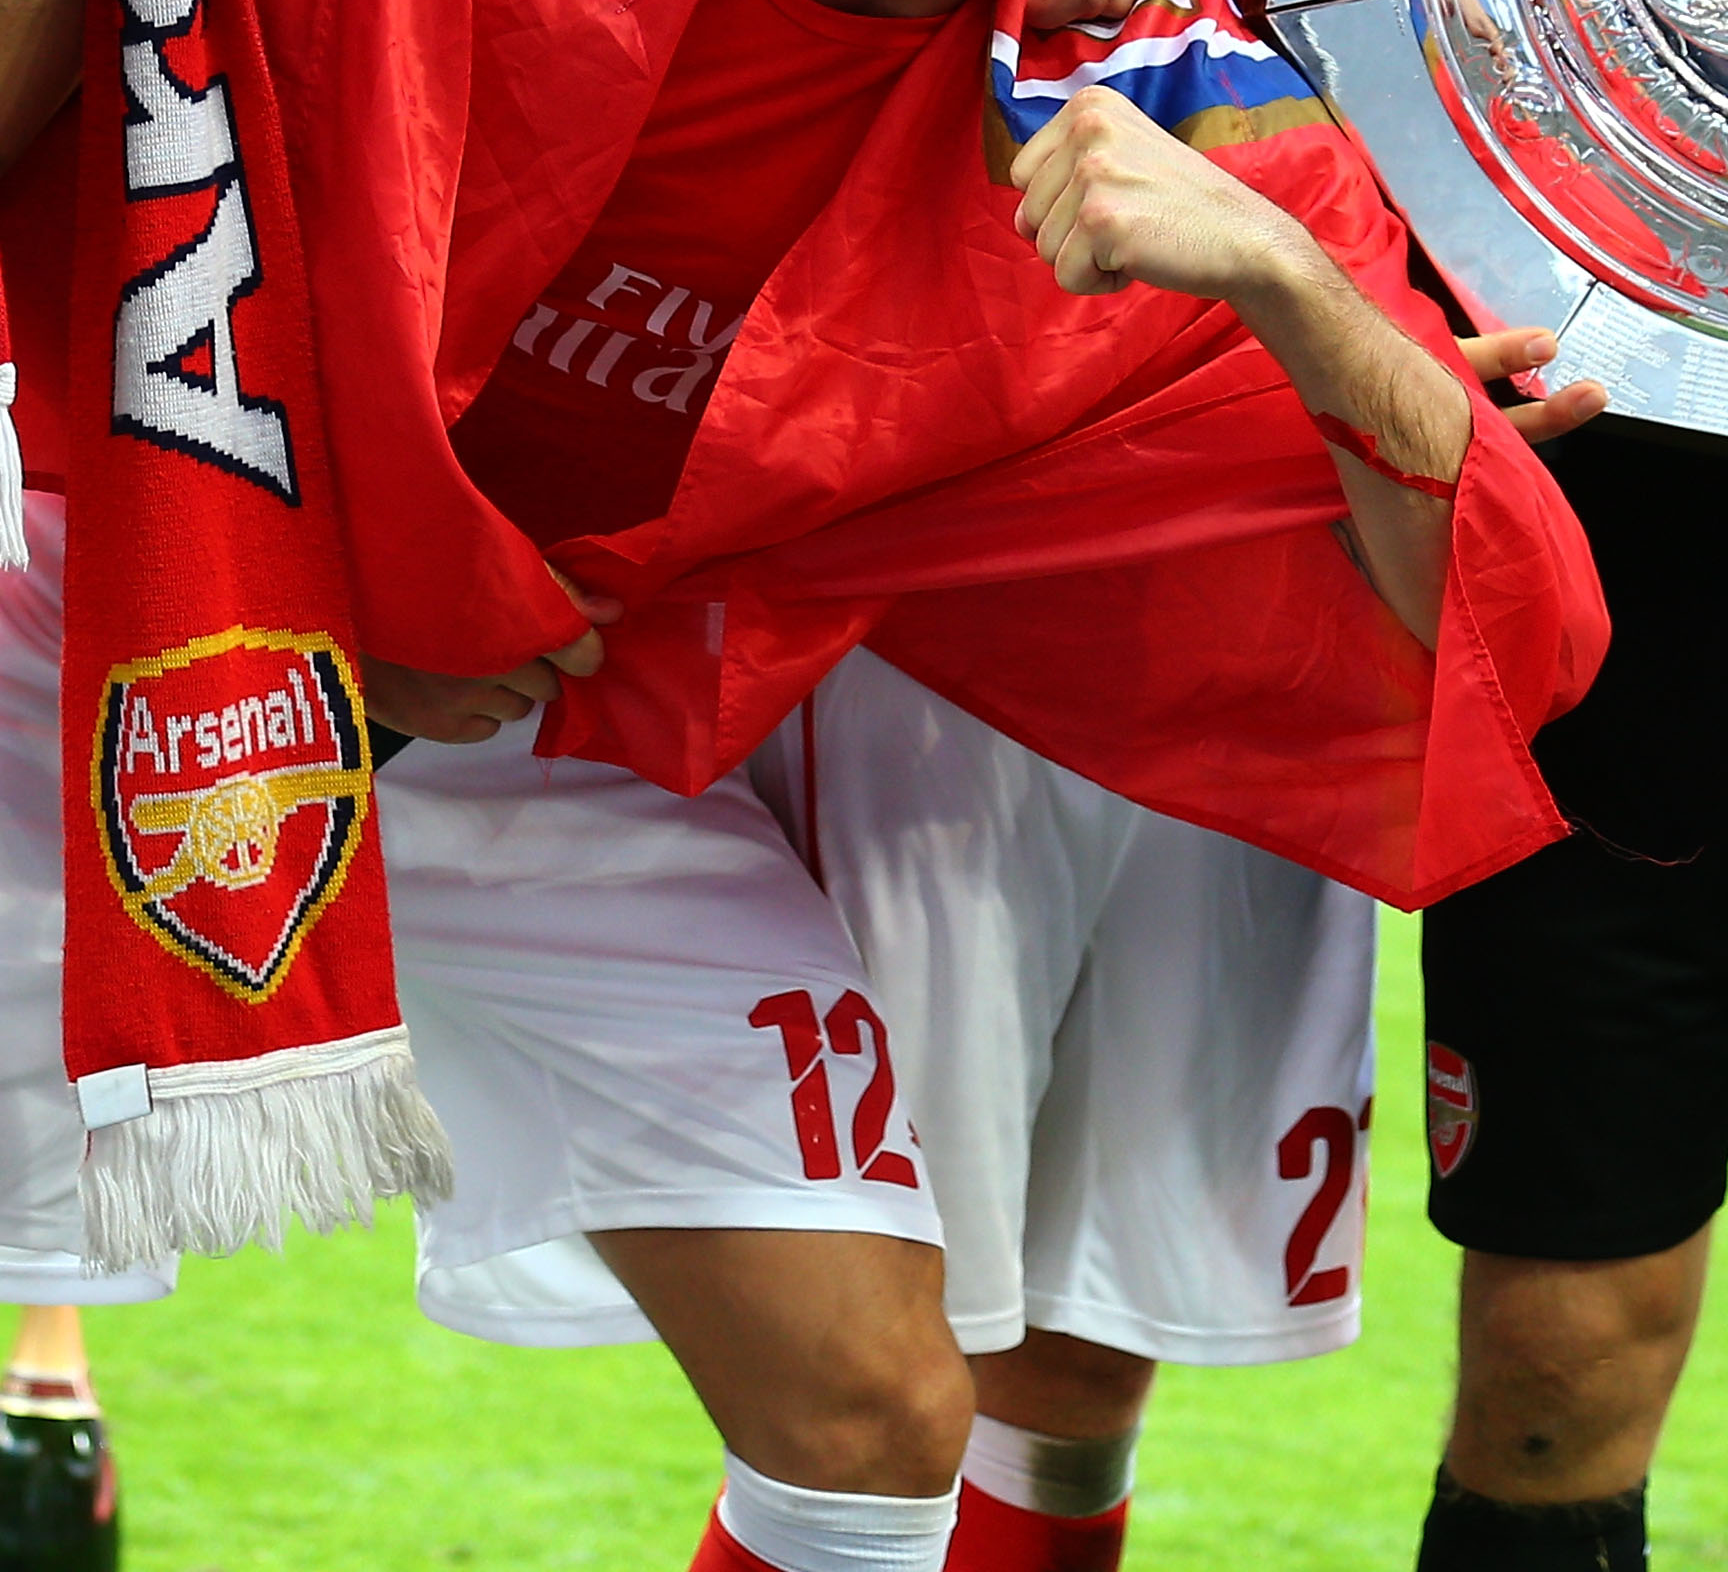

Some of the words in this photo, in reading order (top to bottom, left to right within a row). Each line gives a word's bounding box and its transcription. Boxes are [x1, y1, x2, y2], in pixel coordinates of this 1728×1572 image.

[586, 262, 747, 354] Fly
[126, 668, 314, 773] Arsenal
[747, 989, 919, 1190] 12
